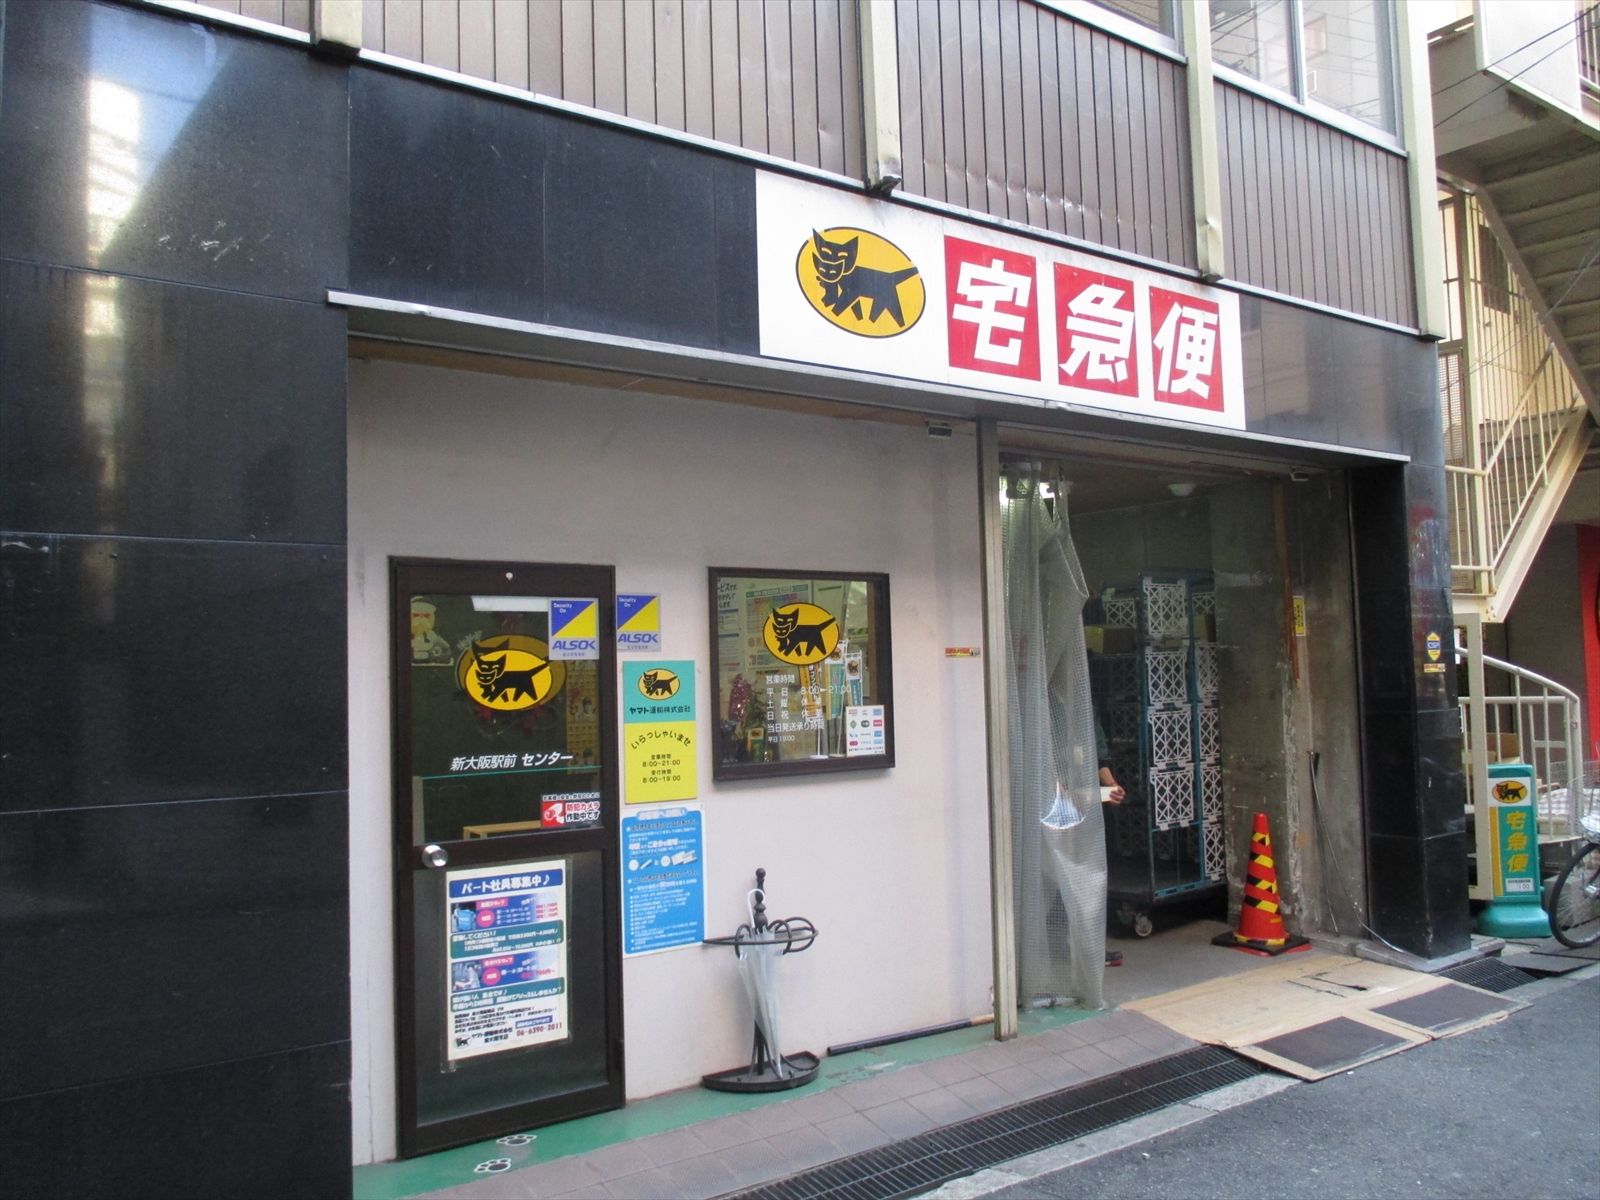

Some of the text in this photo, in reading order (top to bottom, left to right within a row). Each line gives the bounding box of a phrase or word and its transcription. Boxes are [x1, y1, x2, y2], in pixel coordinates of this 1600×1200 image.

[952, 258, 1219, 399] 宅急便
[552, 640, 596, 650] ALSOK
[617, 633, 658, 643] ALSOK
[631, 730, 691, 750] いらっしゃいませ
[450, 751, 573, 771] 新大阪駅前 センター
